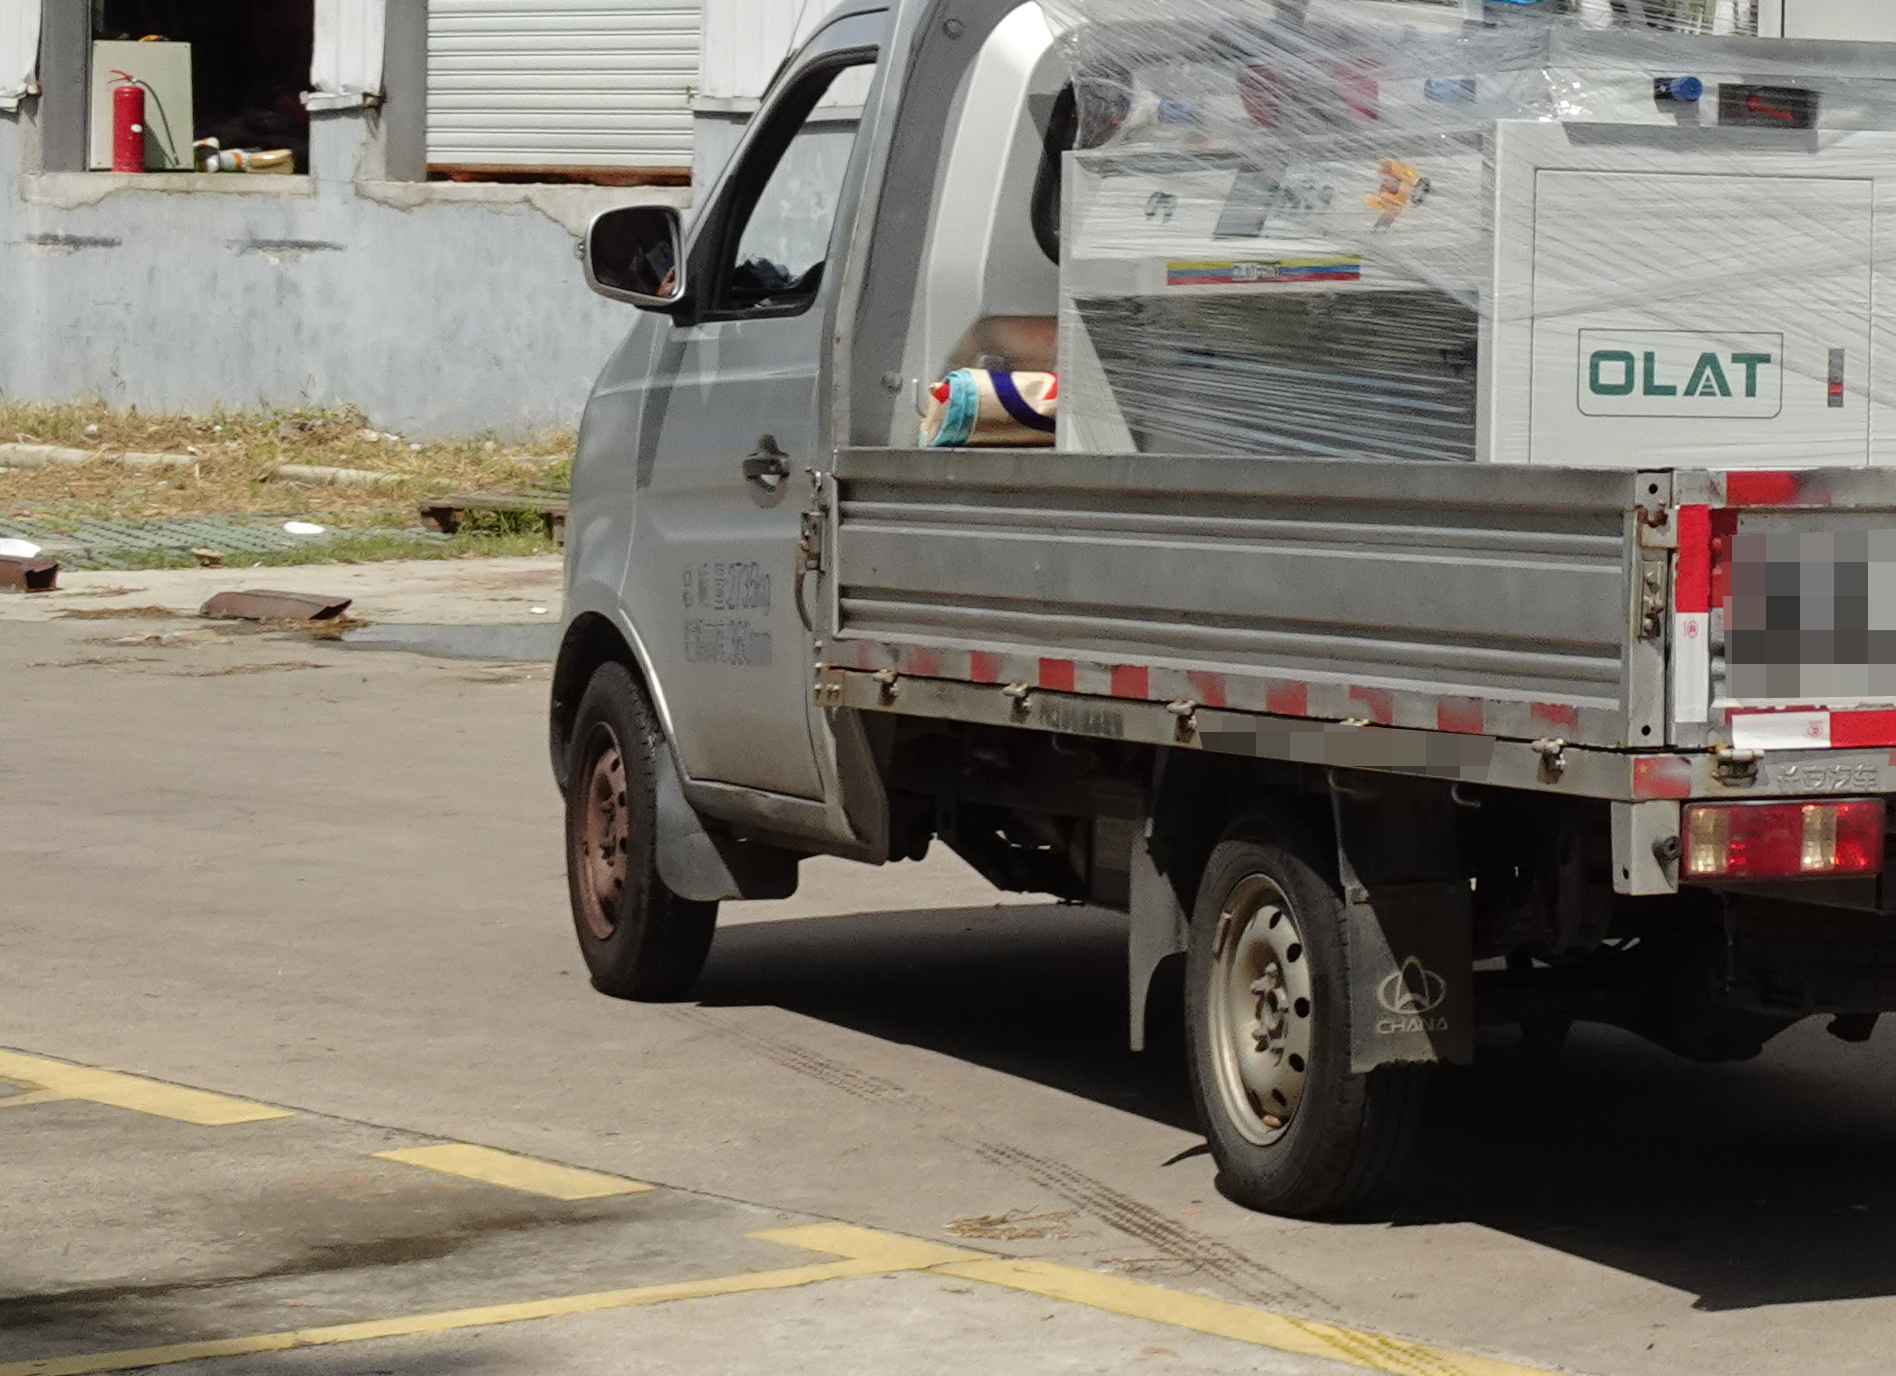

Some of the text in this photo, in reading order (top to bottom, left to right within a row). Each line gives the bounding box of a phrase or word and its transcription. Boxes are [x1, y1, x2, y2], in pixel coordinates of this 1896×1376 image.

[1589, 351, 1771, 397] OLAT
[1777, 764, 1877, 791] 长安汽车
[1377, 1017, 1448, 1034] CHANA
